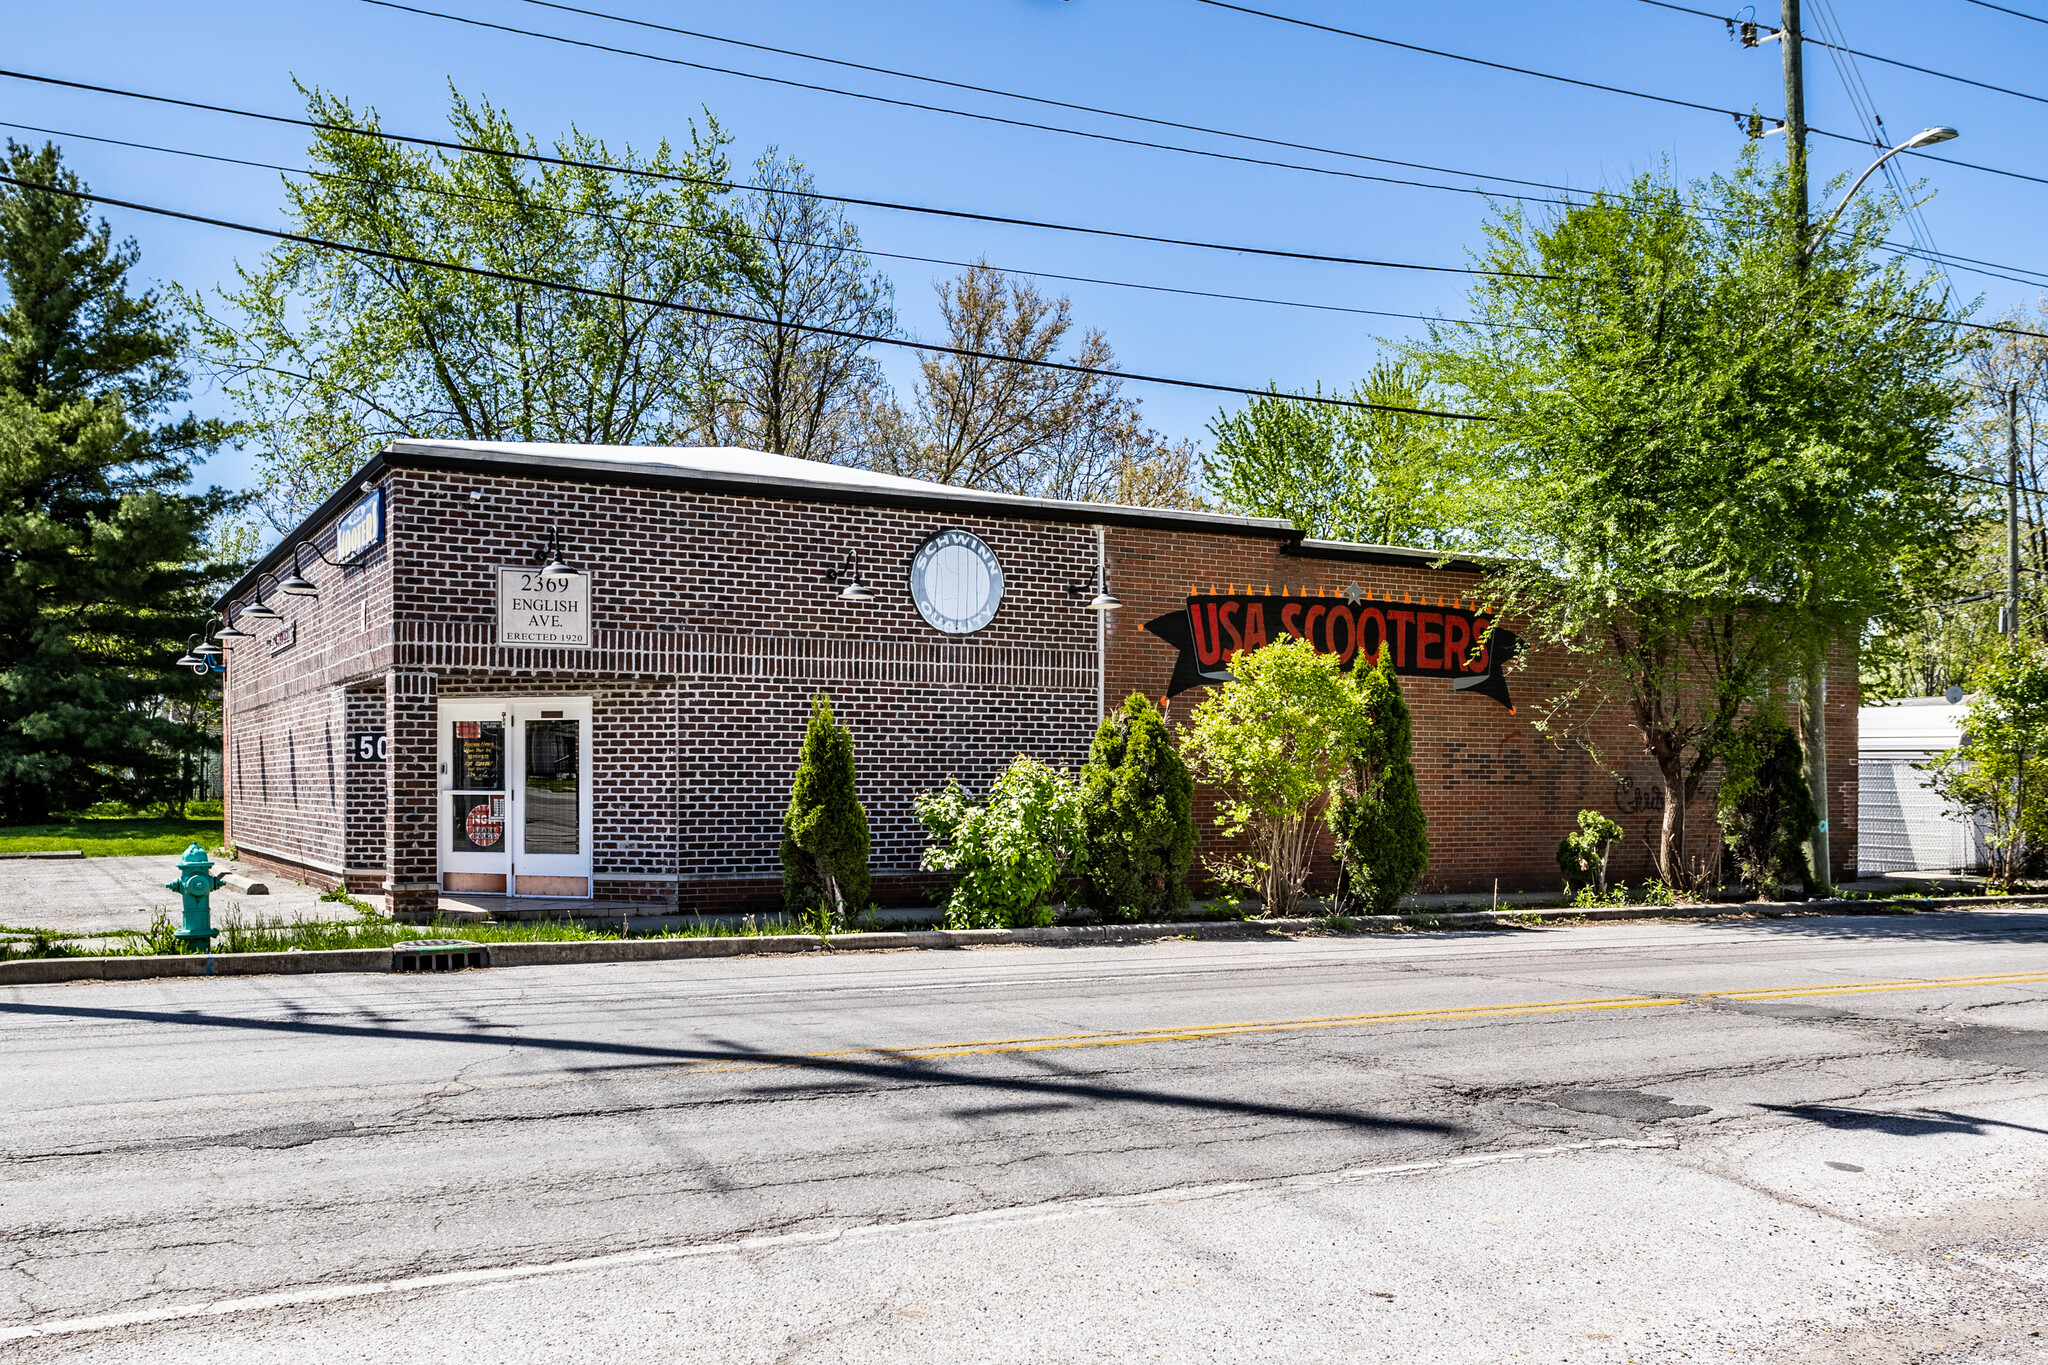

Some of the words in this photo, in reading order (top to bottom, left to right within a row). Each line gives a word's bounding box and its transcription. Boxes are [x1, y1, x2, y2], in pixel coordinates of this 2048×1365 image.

[916, 533, 998, 576] SCHWINN
[521, 574, 569, 592] 2369
[512, 598, 579, 613] ENGLISH
[528, 614, 563, 628] AVE.
[920, 600, 992, 632] QUALITY
[506, 632, 557, 642] ERECTED
[561, 634, 583, 643] 1920
[1190, 600, 1268, 666] USA
[1281, 602, 1490, 674] SCOOTERS
